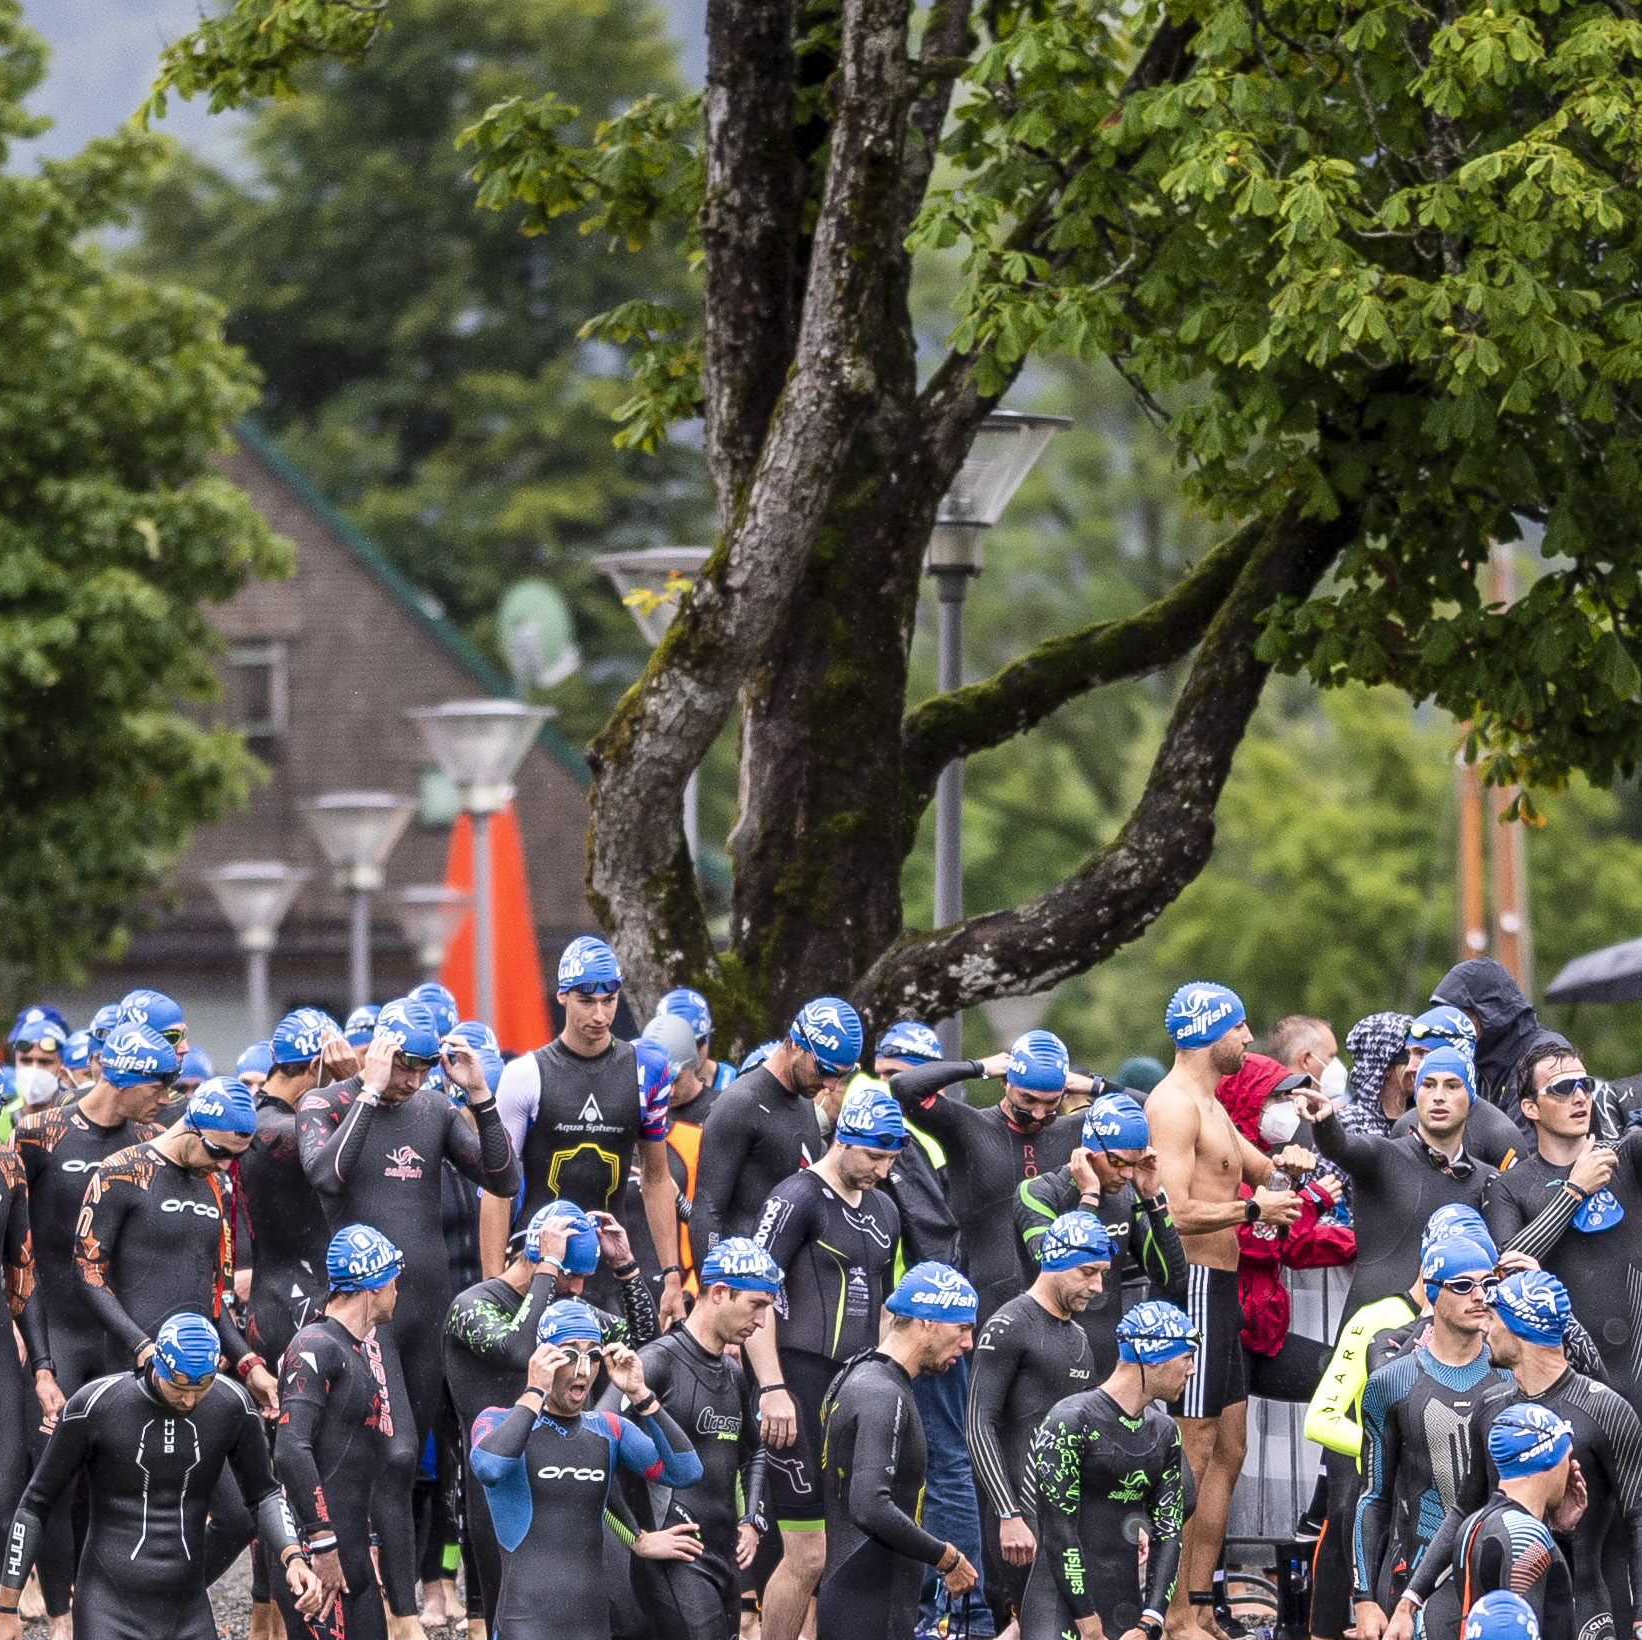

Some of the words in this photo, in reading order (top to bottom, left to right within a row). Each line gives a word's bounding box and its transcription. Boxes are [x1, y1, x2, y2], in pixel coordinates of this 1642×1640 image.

[1176, 1002, 1232, 1040] sailfish
[556, 1123, 590, 1135] Aqua
[593, 1123, 625, 1134] Sphere
[62, 1160, 101, 1173] or
[161, 1199, 219, 1220] orca
[1104, 1222, 1130, 1236] ca
[348, 1246, 394, 1275] Kult
[911, 1289, 978, 1308] sailfish
[1069, 1368, 1089, 1378] 2XU
[164, 1419, 174, 1453] HUUB
[538, 1466, 604, 1481] orca
[8, 1522, 25, 1577] HUUB
[1063, 1548, 1084, 1595] sailfish
